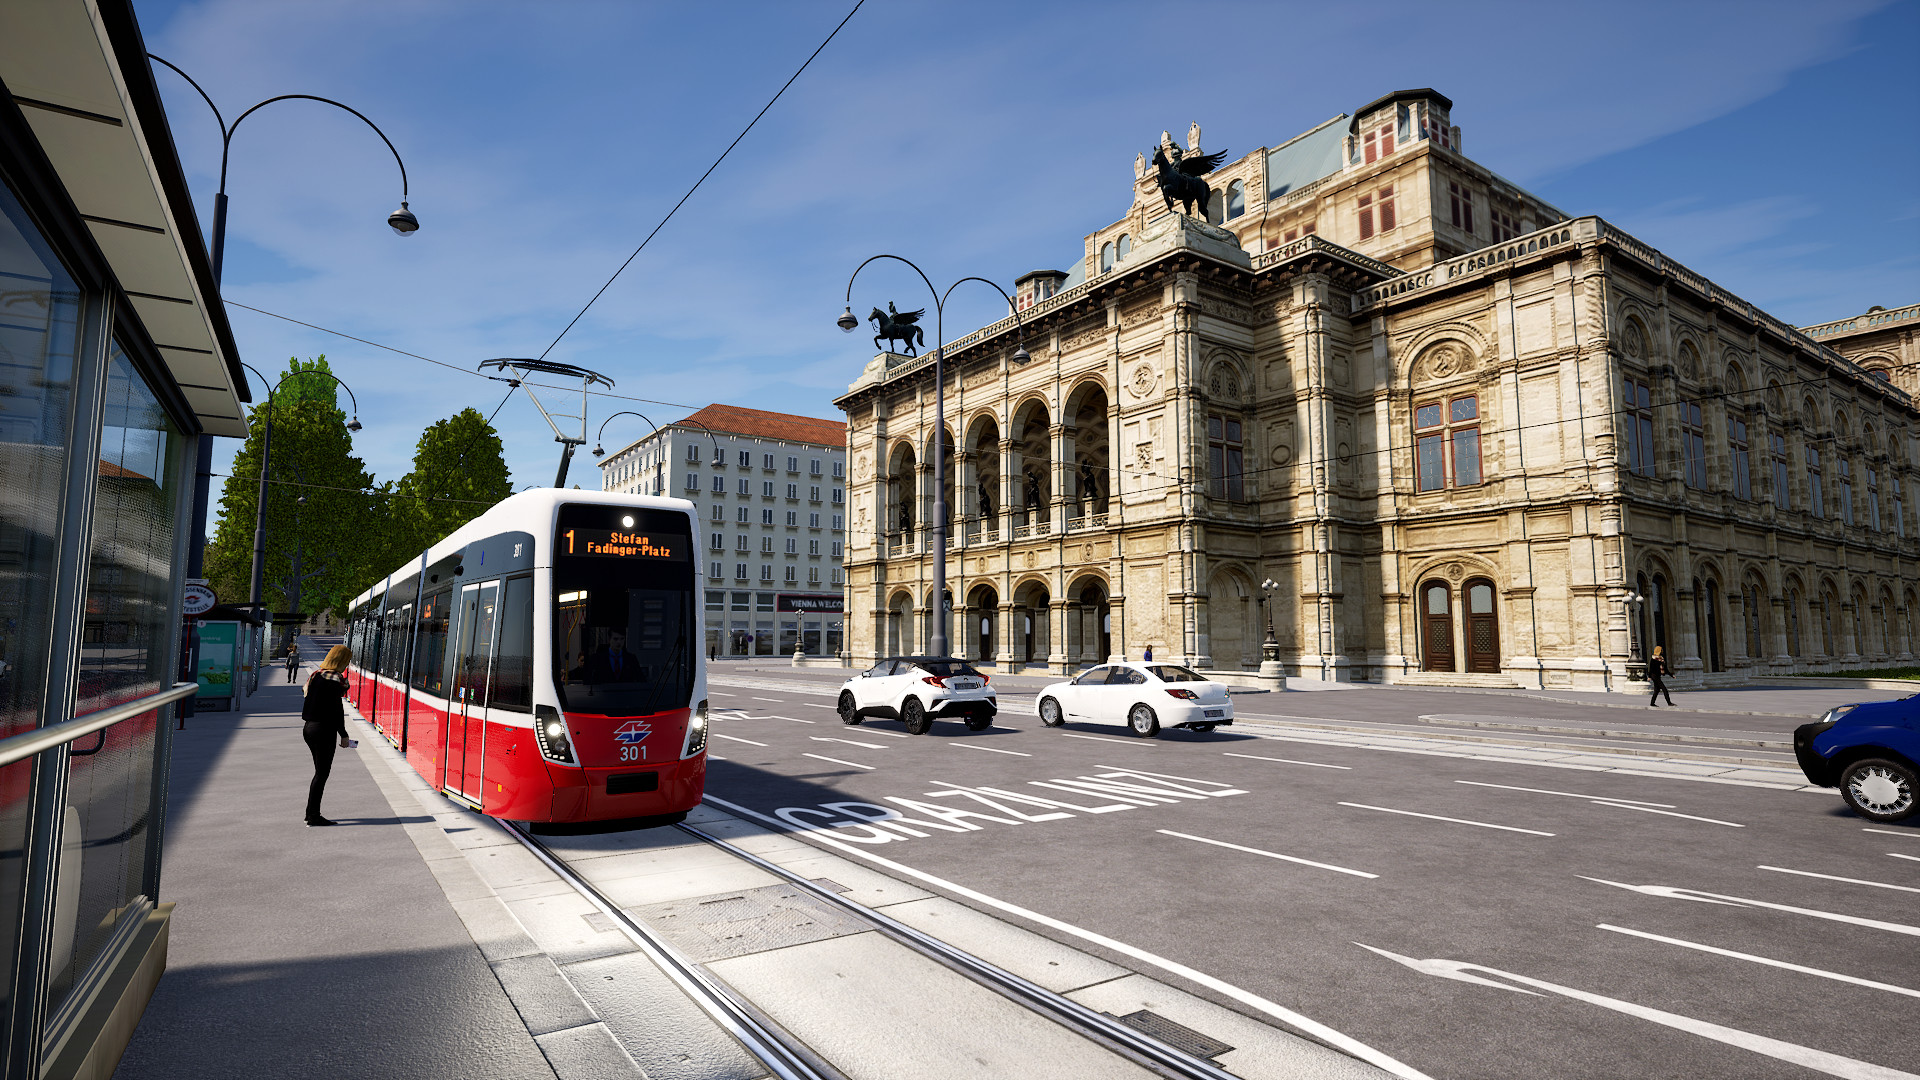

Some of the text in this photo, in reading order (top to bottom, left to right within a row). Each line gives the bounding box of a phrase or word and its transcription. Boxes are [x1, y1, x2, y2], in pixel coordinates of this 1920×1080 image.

[565, 529, 575, 554] 1
[610, 532, 649, 545] Stefan
[587, 541, 671, 557] Fadinger-Platz
[790, 599, 844, 608] VIENNA WELCO
[620, 745, 647, 762] 301
[774, 772, 1251, 844] GRAZ LINZ
